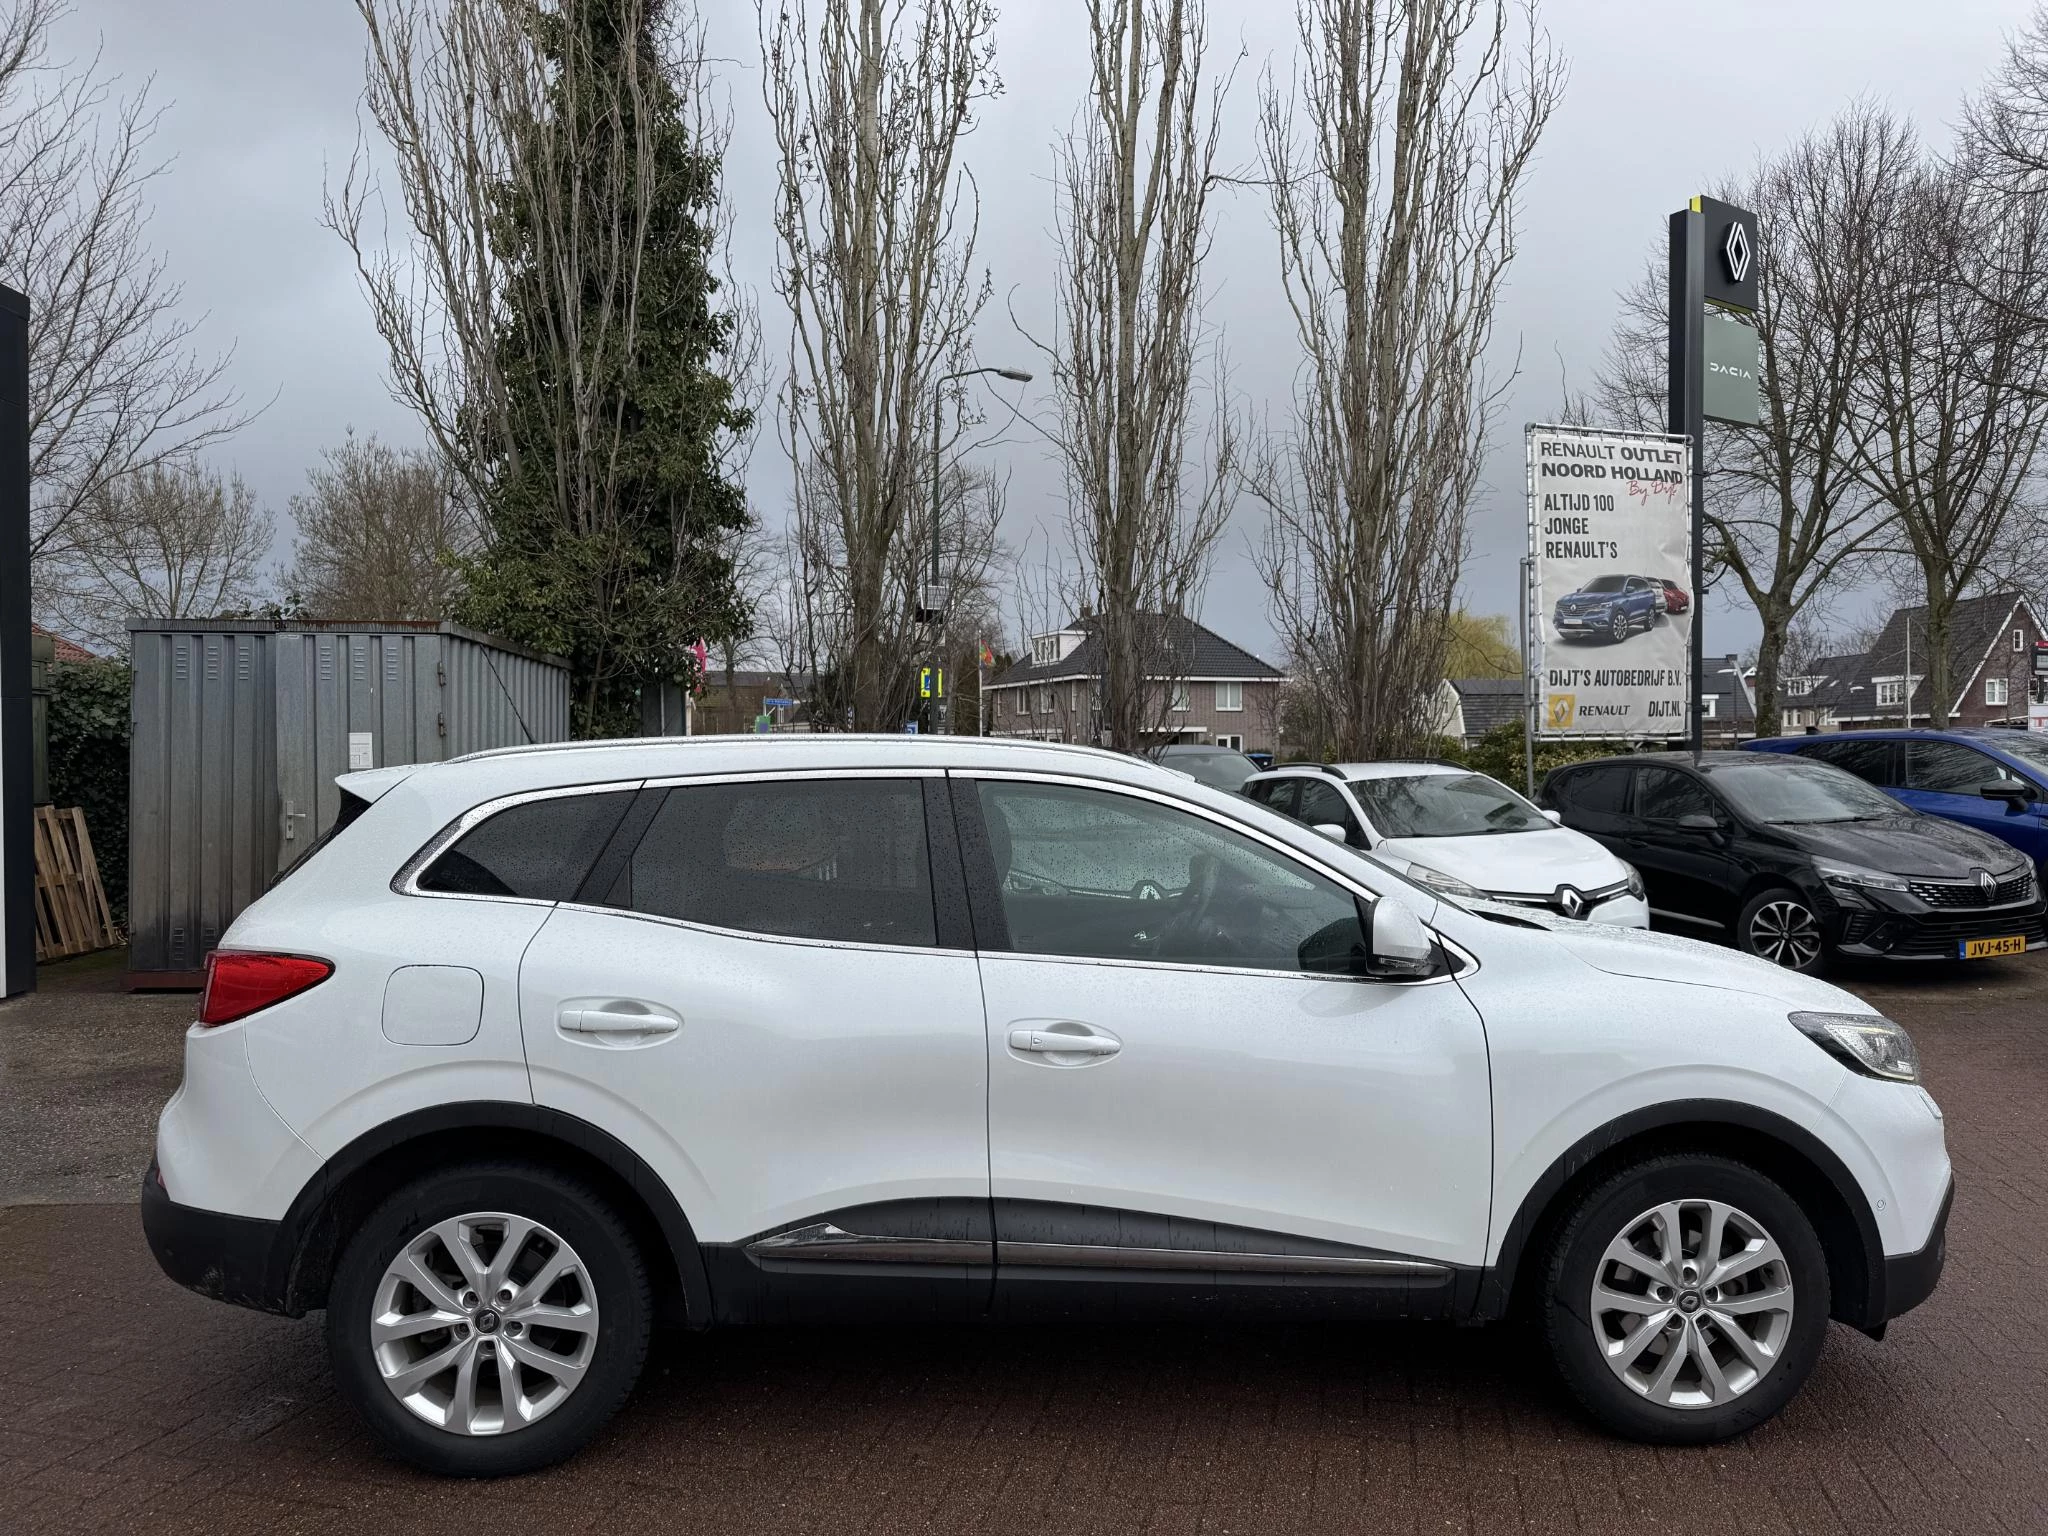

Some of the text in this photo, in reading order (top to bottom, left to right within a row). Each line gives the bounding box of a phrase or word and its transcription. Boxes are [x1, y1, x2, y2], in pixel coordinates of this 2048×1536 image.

[1710, 362, 1751, 380] DACIA
[1540, 442, 1682, 464] RENAULT OUTLET
[1541, 463, 1683, 485] NOORD HOLLAND
[1544, 493, 1614, 511] ALTIJD 100
[1626, 480, 1650, 506] By
[1544, 517, 1589, 535] JONGE
[1545, 541, 1618, 559] RENAULT'S
[1549, 669, 1682, 686] DIJT'S AUTOBEDRIJF B.V.
[1579, 704, 1631, 716] RENAULT
[1648, 700, 1682, 717] DIJT.NL
[1970, 938, 2021, 956] JVJ-45-H
